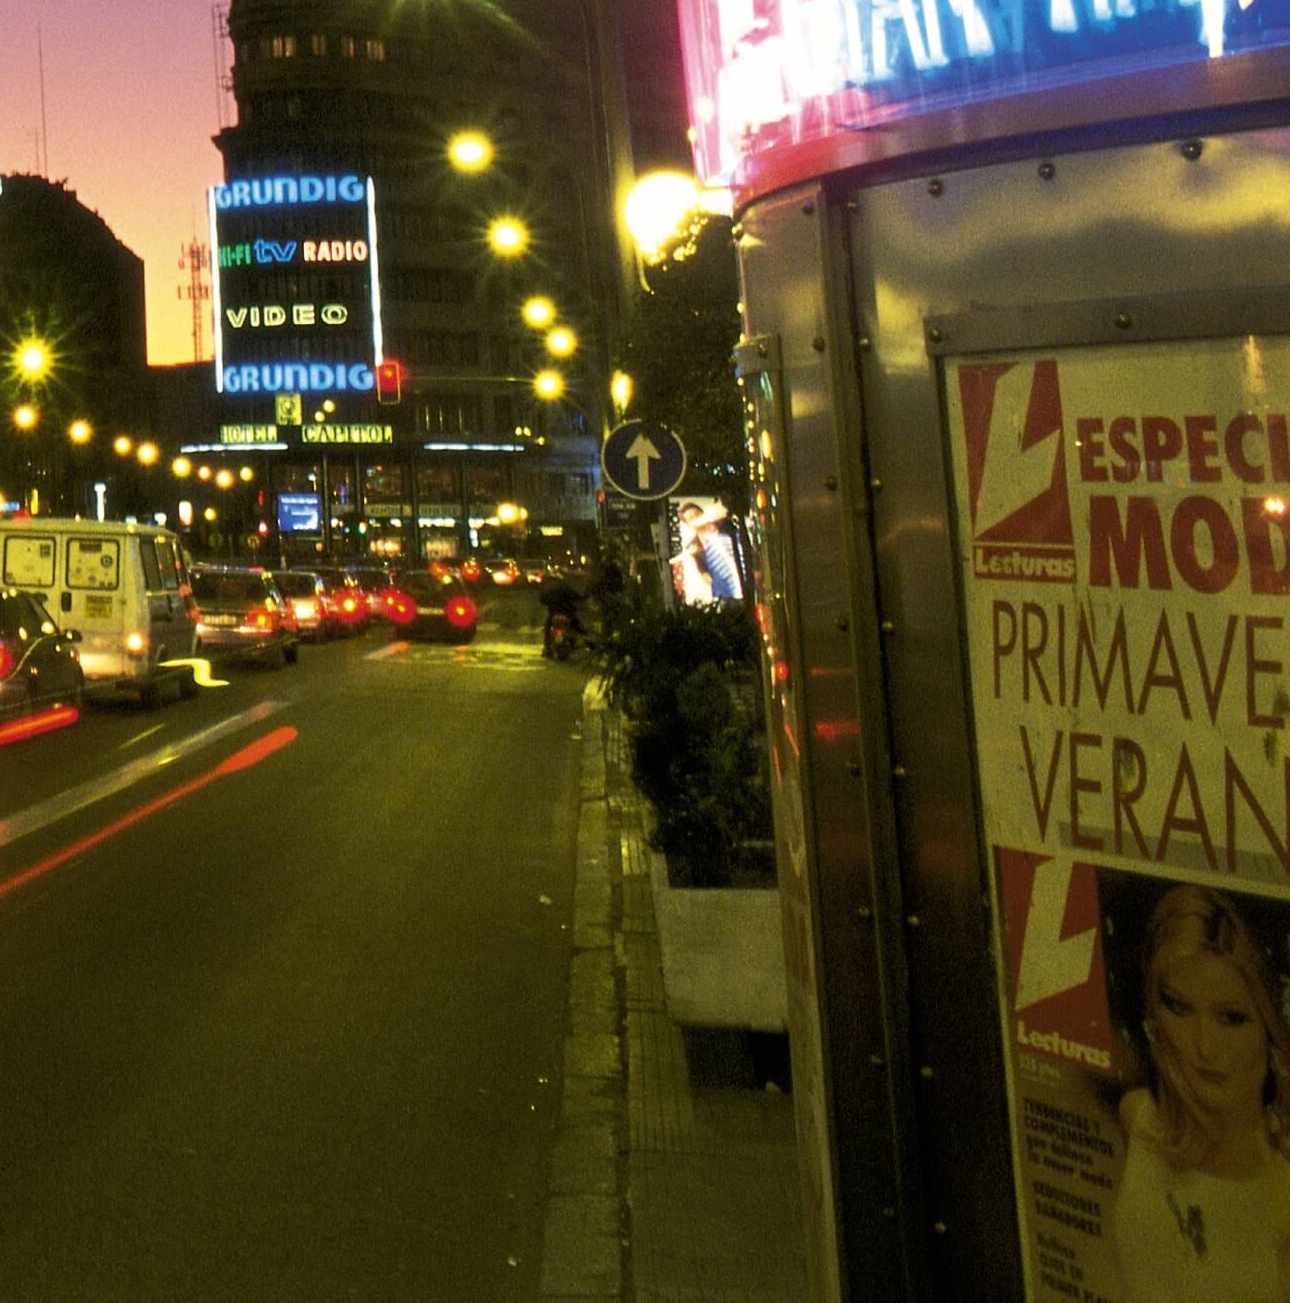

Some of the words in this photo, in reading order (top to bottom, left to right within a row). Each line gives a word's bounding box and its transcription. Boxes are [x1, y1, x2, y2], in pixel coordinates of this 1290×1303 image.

[213, 176, 364, 209] GRUNDIG
[253, 238, 298, 264] tv
[303, 240, 368, 263] RADIO
[225, 304, 348, 328] VIDEO
[223, 363, 376, 393] GRUNDIG
[301, 424, 394, 444] CAPITOL
[974, 547, 1076, 578] Lecturas
[991, 600, 1286, 730] PRIMAVE
[1016, 1018, 1113, 1071] Lecturas
